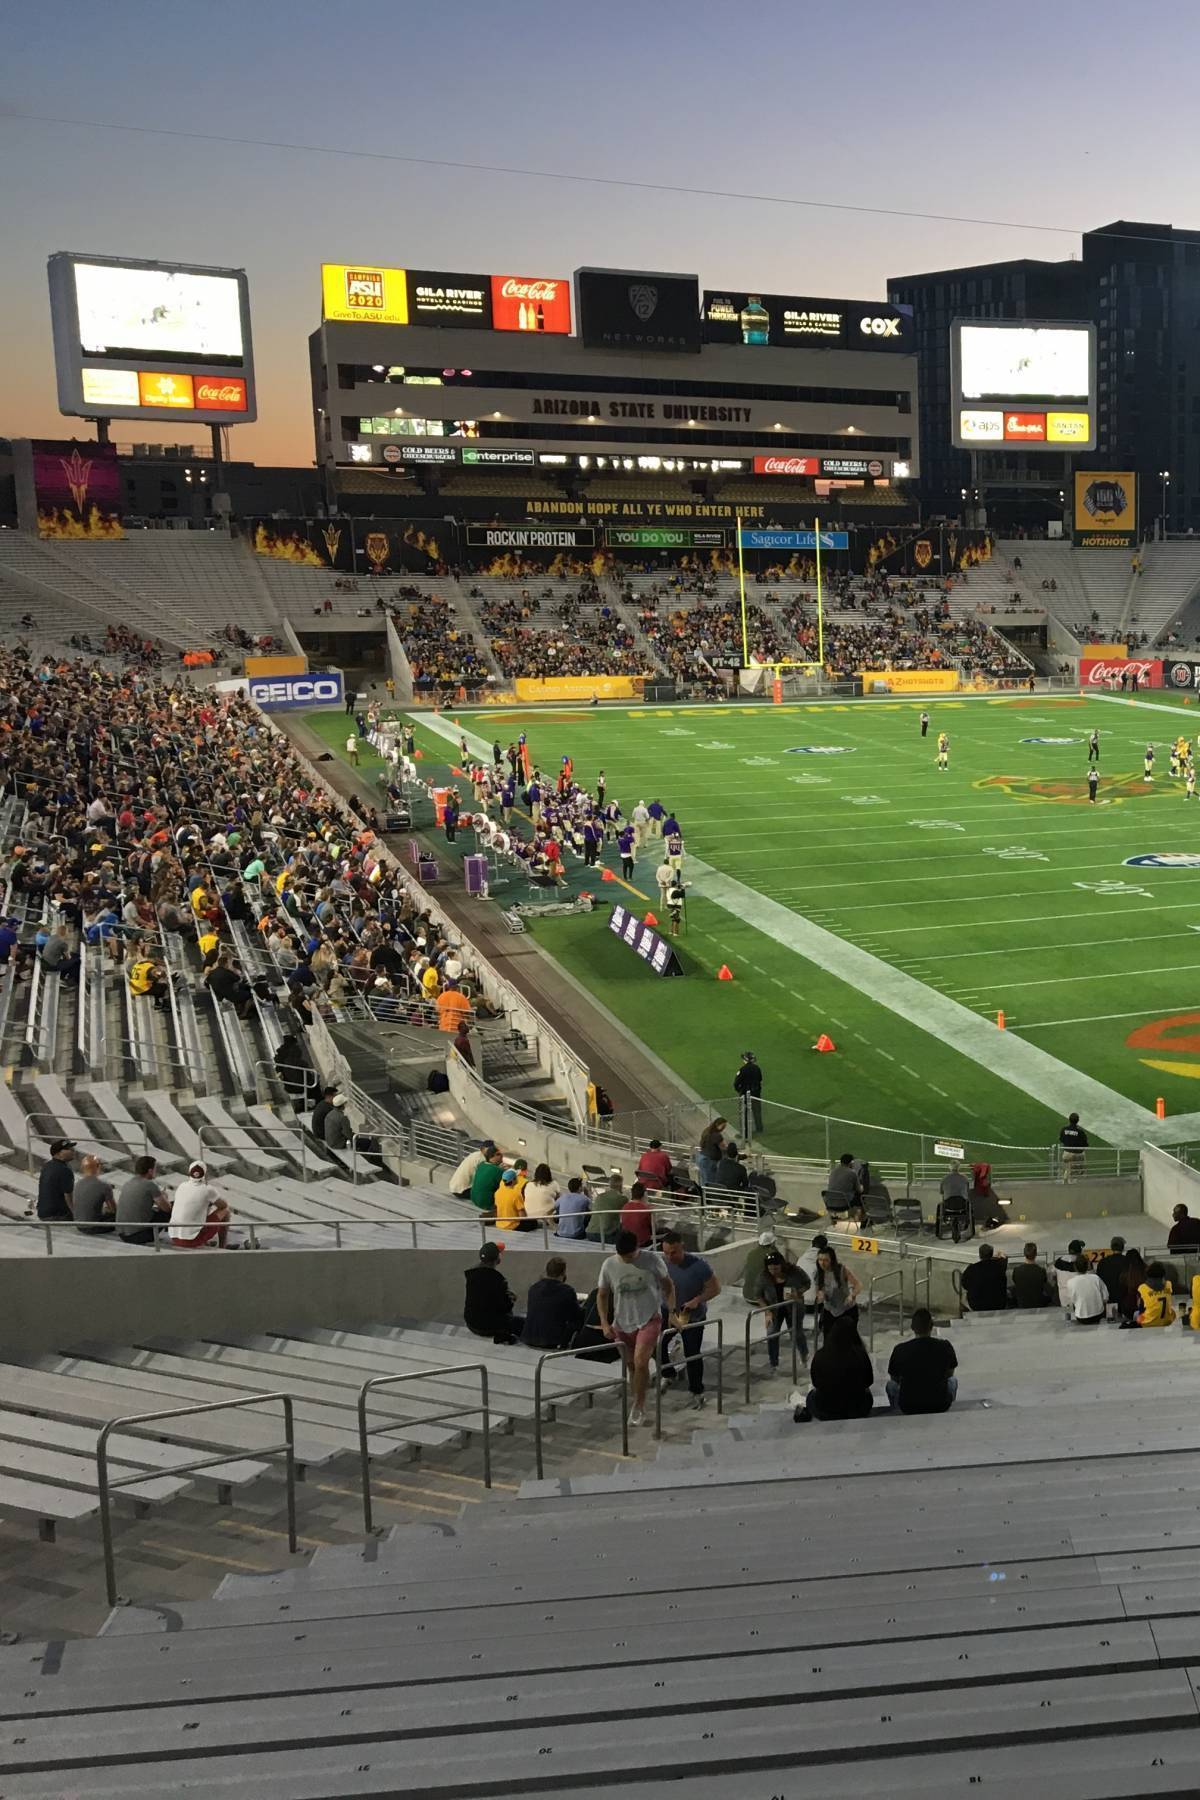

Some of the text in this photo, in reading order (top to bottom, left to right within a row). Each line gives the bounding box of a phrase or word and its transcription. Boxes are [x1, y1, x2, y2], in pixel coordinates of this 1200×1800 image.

[349, 280, 382, 297] ASU
[416, 286, 482, 300] GILA RIVER
[501, 278, 558, 302] Coca-Cola
[349, 295, 382, 307] 2020
[784, 310, 839, 323] GILA RIVER
[860, 317, 901, 337] COX
[602, 332, 686, 345] NETWORKS
[198, 385, 242, 402] Coca-Cola
[532, 399, 751, 422] ARIZONA STATE UNIVERSITY
[465, 451, 532, 462] enterprise
[764, 458, 807, 474] Coca-Cola
[526, 501, 764, 518] ABANDON HOPE ALL YE WHO ENTER HERE
[530, 533, 576, 547] PROTEIN
[616, 532, 683, 543] YOU DO YOU
[750, 531, 791, 547] Sagicor
[1081, 537, 1130, 547] HOTSHOTS
[251, 681, 338, 704] GEICO
[857, 1240, 872, 1251] 22
[1159, 1297, 1167, 1318] 7
